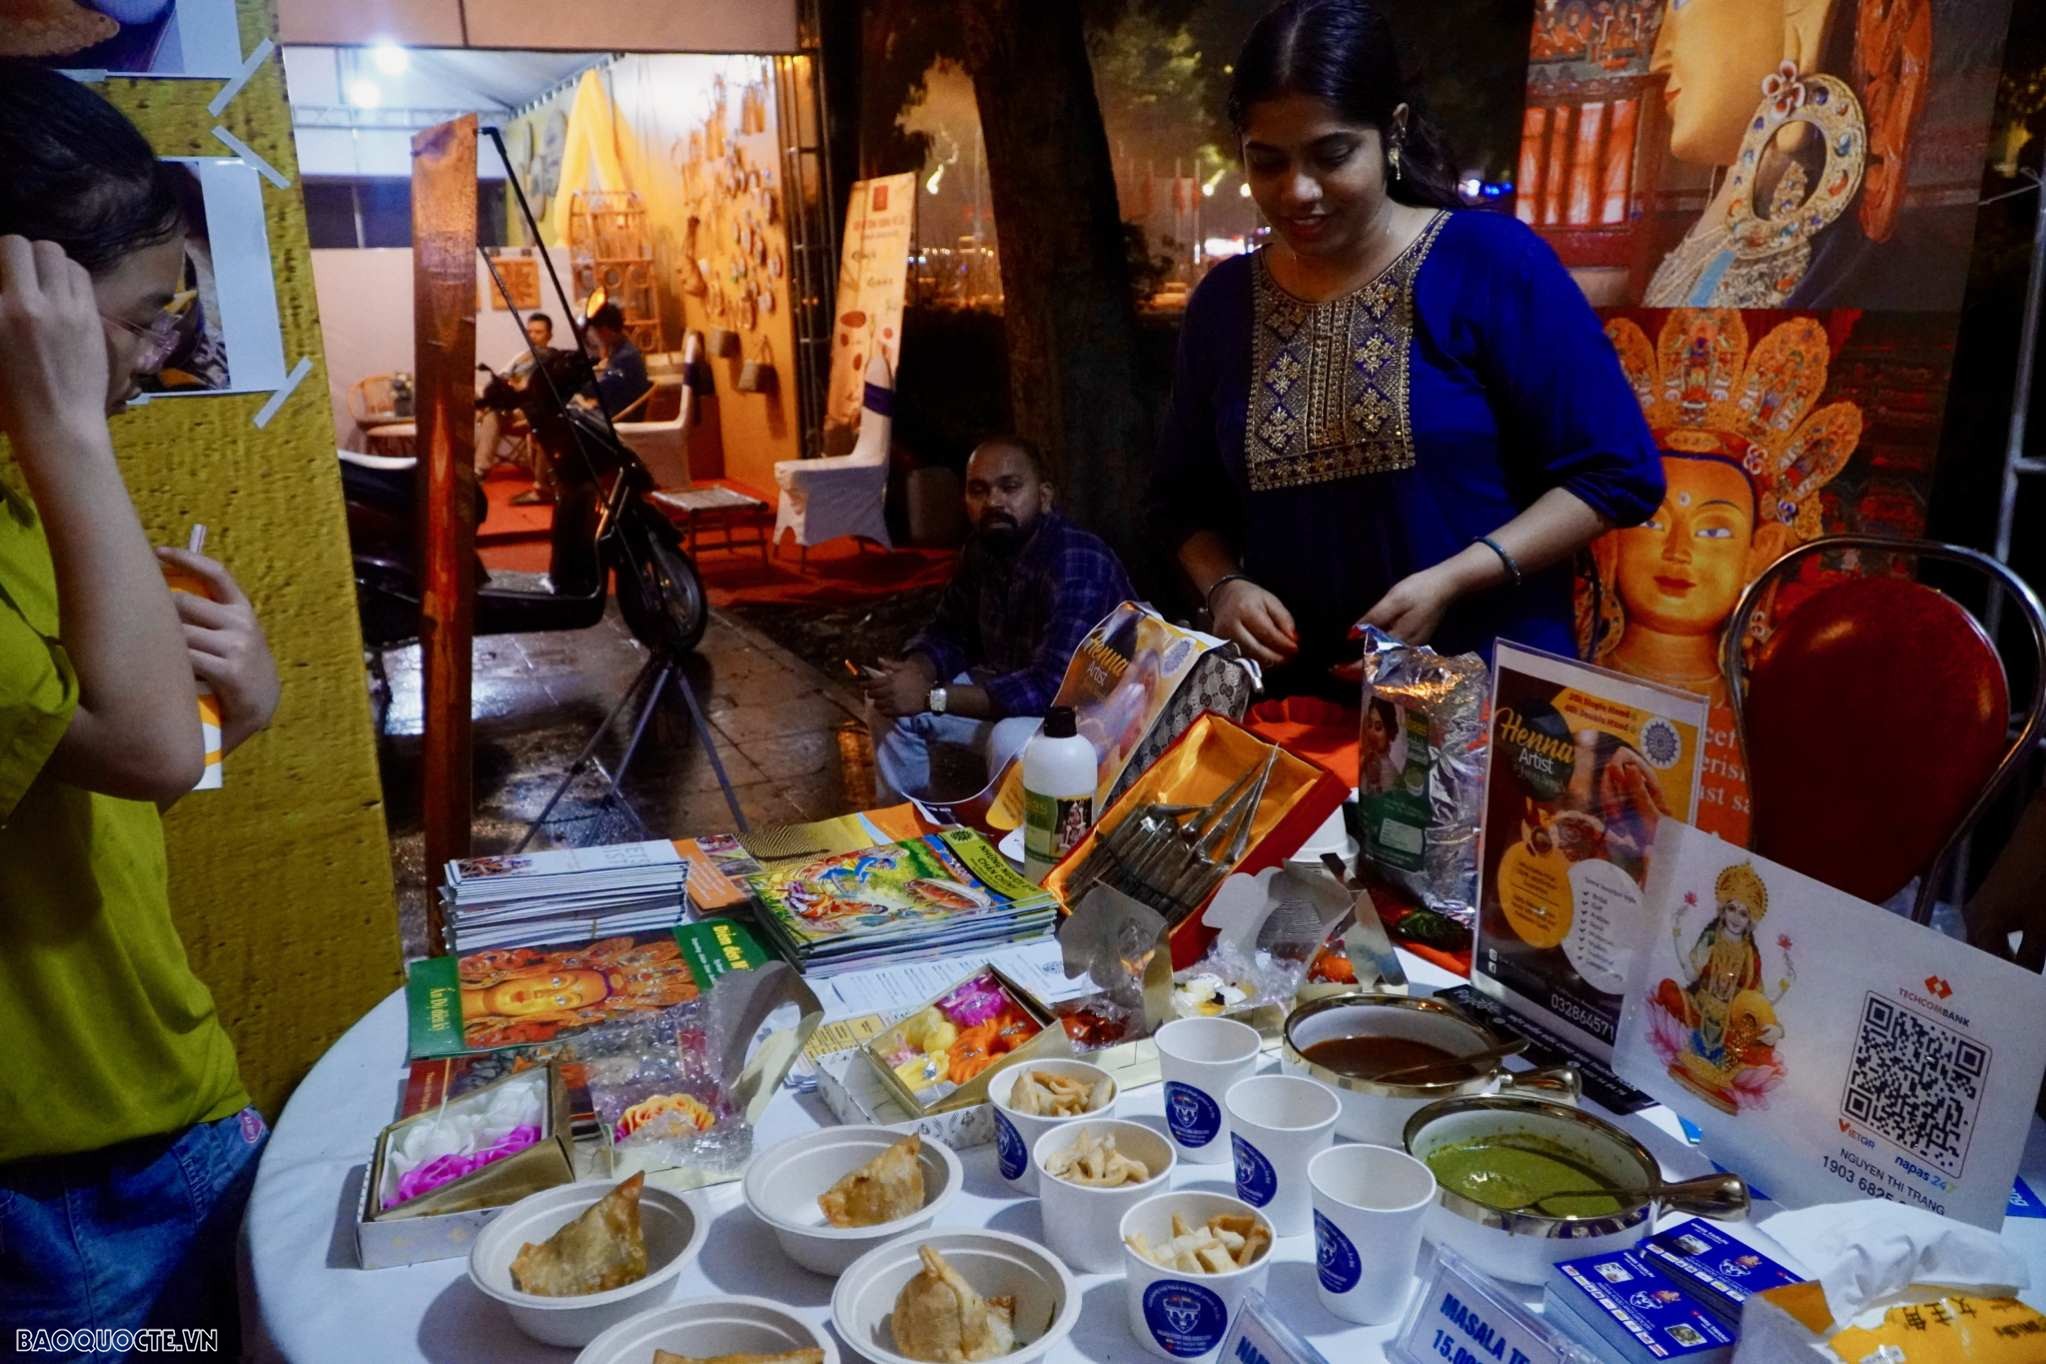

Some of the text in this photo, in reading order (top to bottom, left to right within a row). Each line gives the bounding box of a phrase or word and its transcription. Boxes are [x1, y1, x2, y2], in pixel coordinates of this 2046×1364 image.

[1494, 707, 1575, 764] Henna
[1518, 748, 1555, 774] Artist
[1898, 987, 1970, 1026] TECHCOMBANK
[1822, 1155, 1856, 1183] 1903
[1839, 1148, 1945, 1216] NGUYEN THI TRANG
[1894, 1155, 1930, 1181] napas
[1440, 1292, 1507, 1361] MASALA
